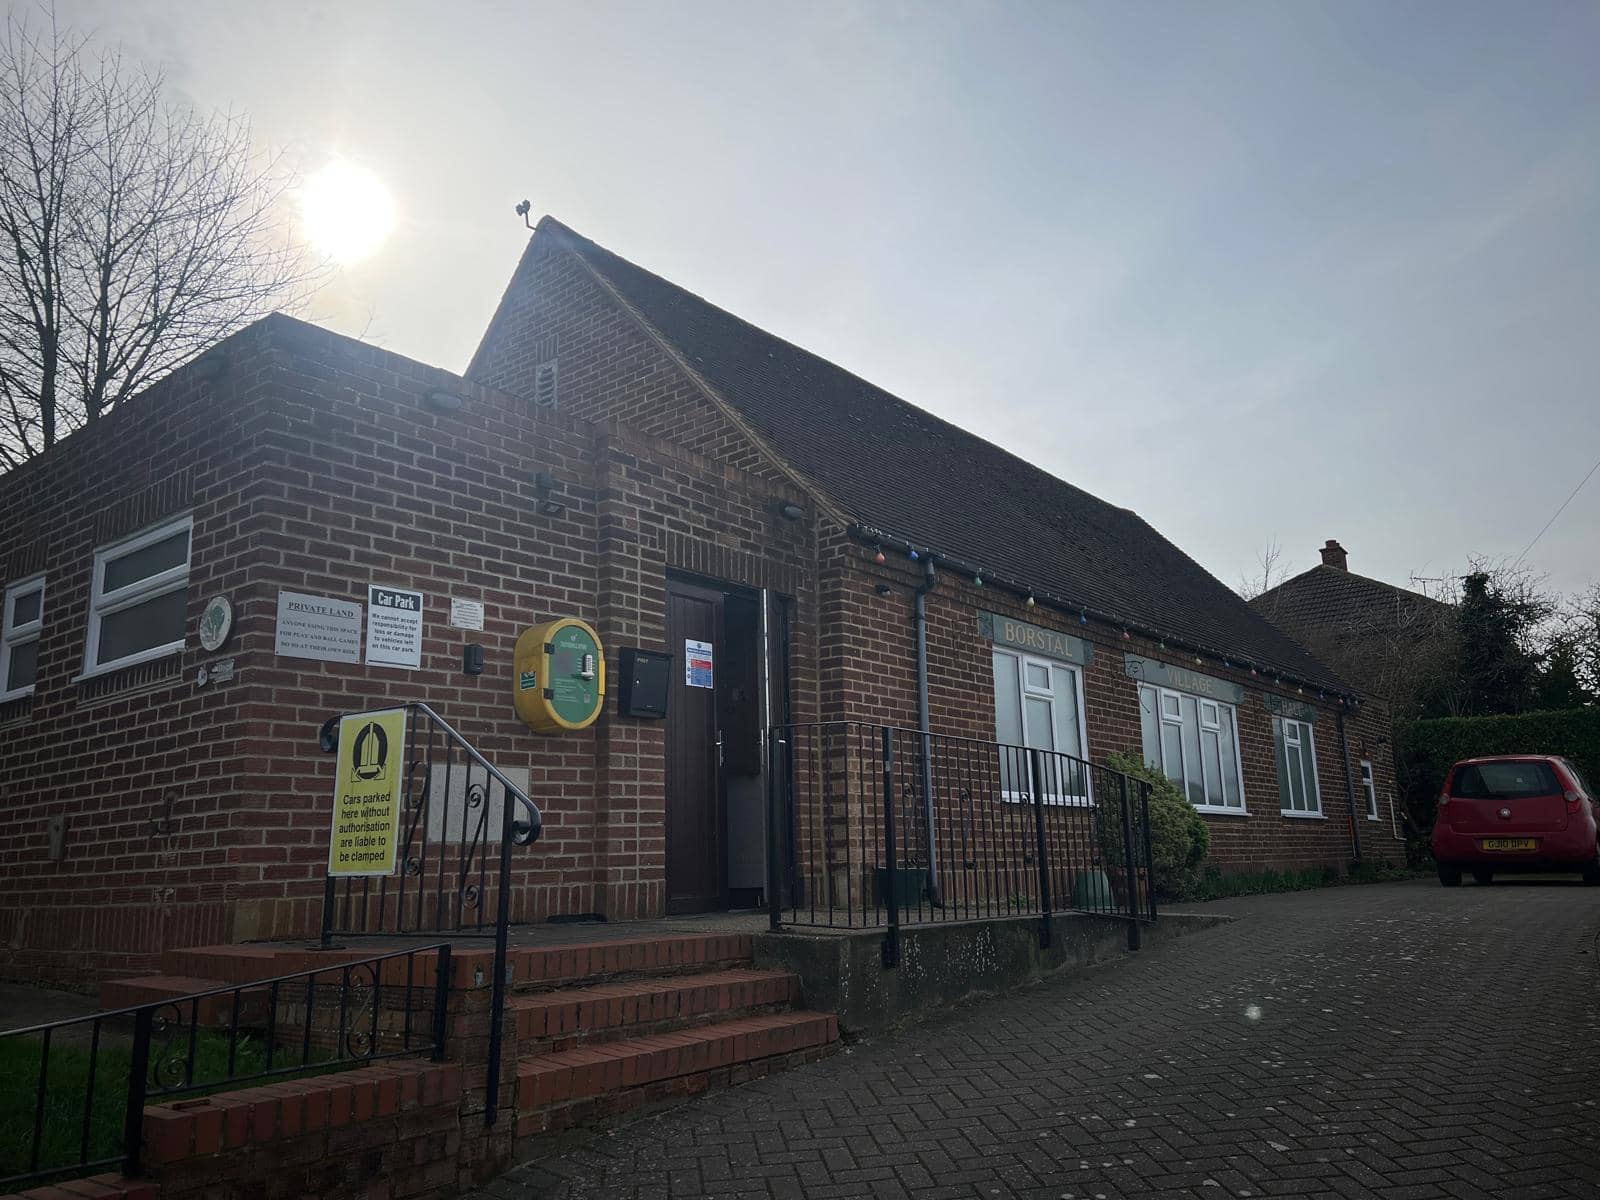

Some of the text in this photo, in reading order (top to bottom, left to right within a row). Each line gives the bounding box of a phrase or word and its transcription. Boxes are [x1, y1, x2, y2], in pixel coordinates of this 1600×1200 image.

[378, 592, 414, 609] Car Park
[288, 602, 354, 618] PRIVATE LAND
[281, 620, 306, 628] ANYONE
[372, 622, 408, 630] responsibility
[1004, 622, 1073, 657] BORSTAL
[1167, 670, 1214, 694] VILLAGE
[343, 792, 391, 805] Cars parked
[342, 806, 390, 819] here without
[339, 821, 390, 834] authorisation
[340, 836, 386, 848] are liable to
[340, 850, 385, 864] be clamped
